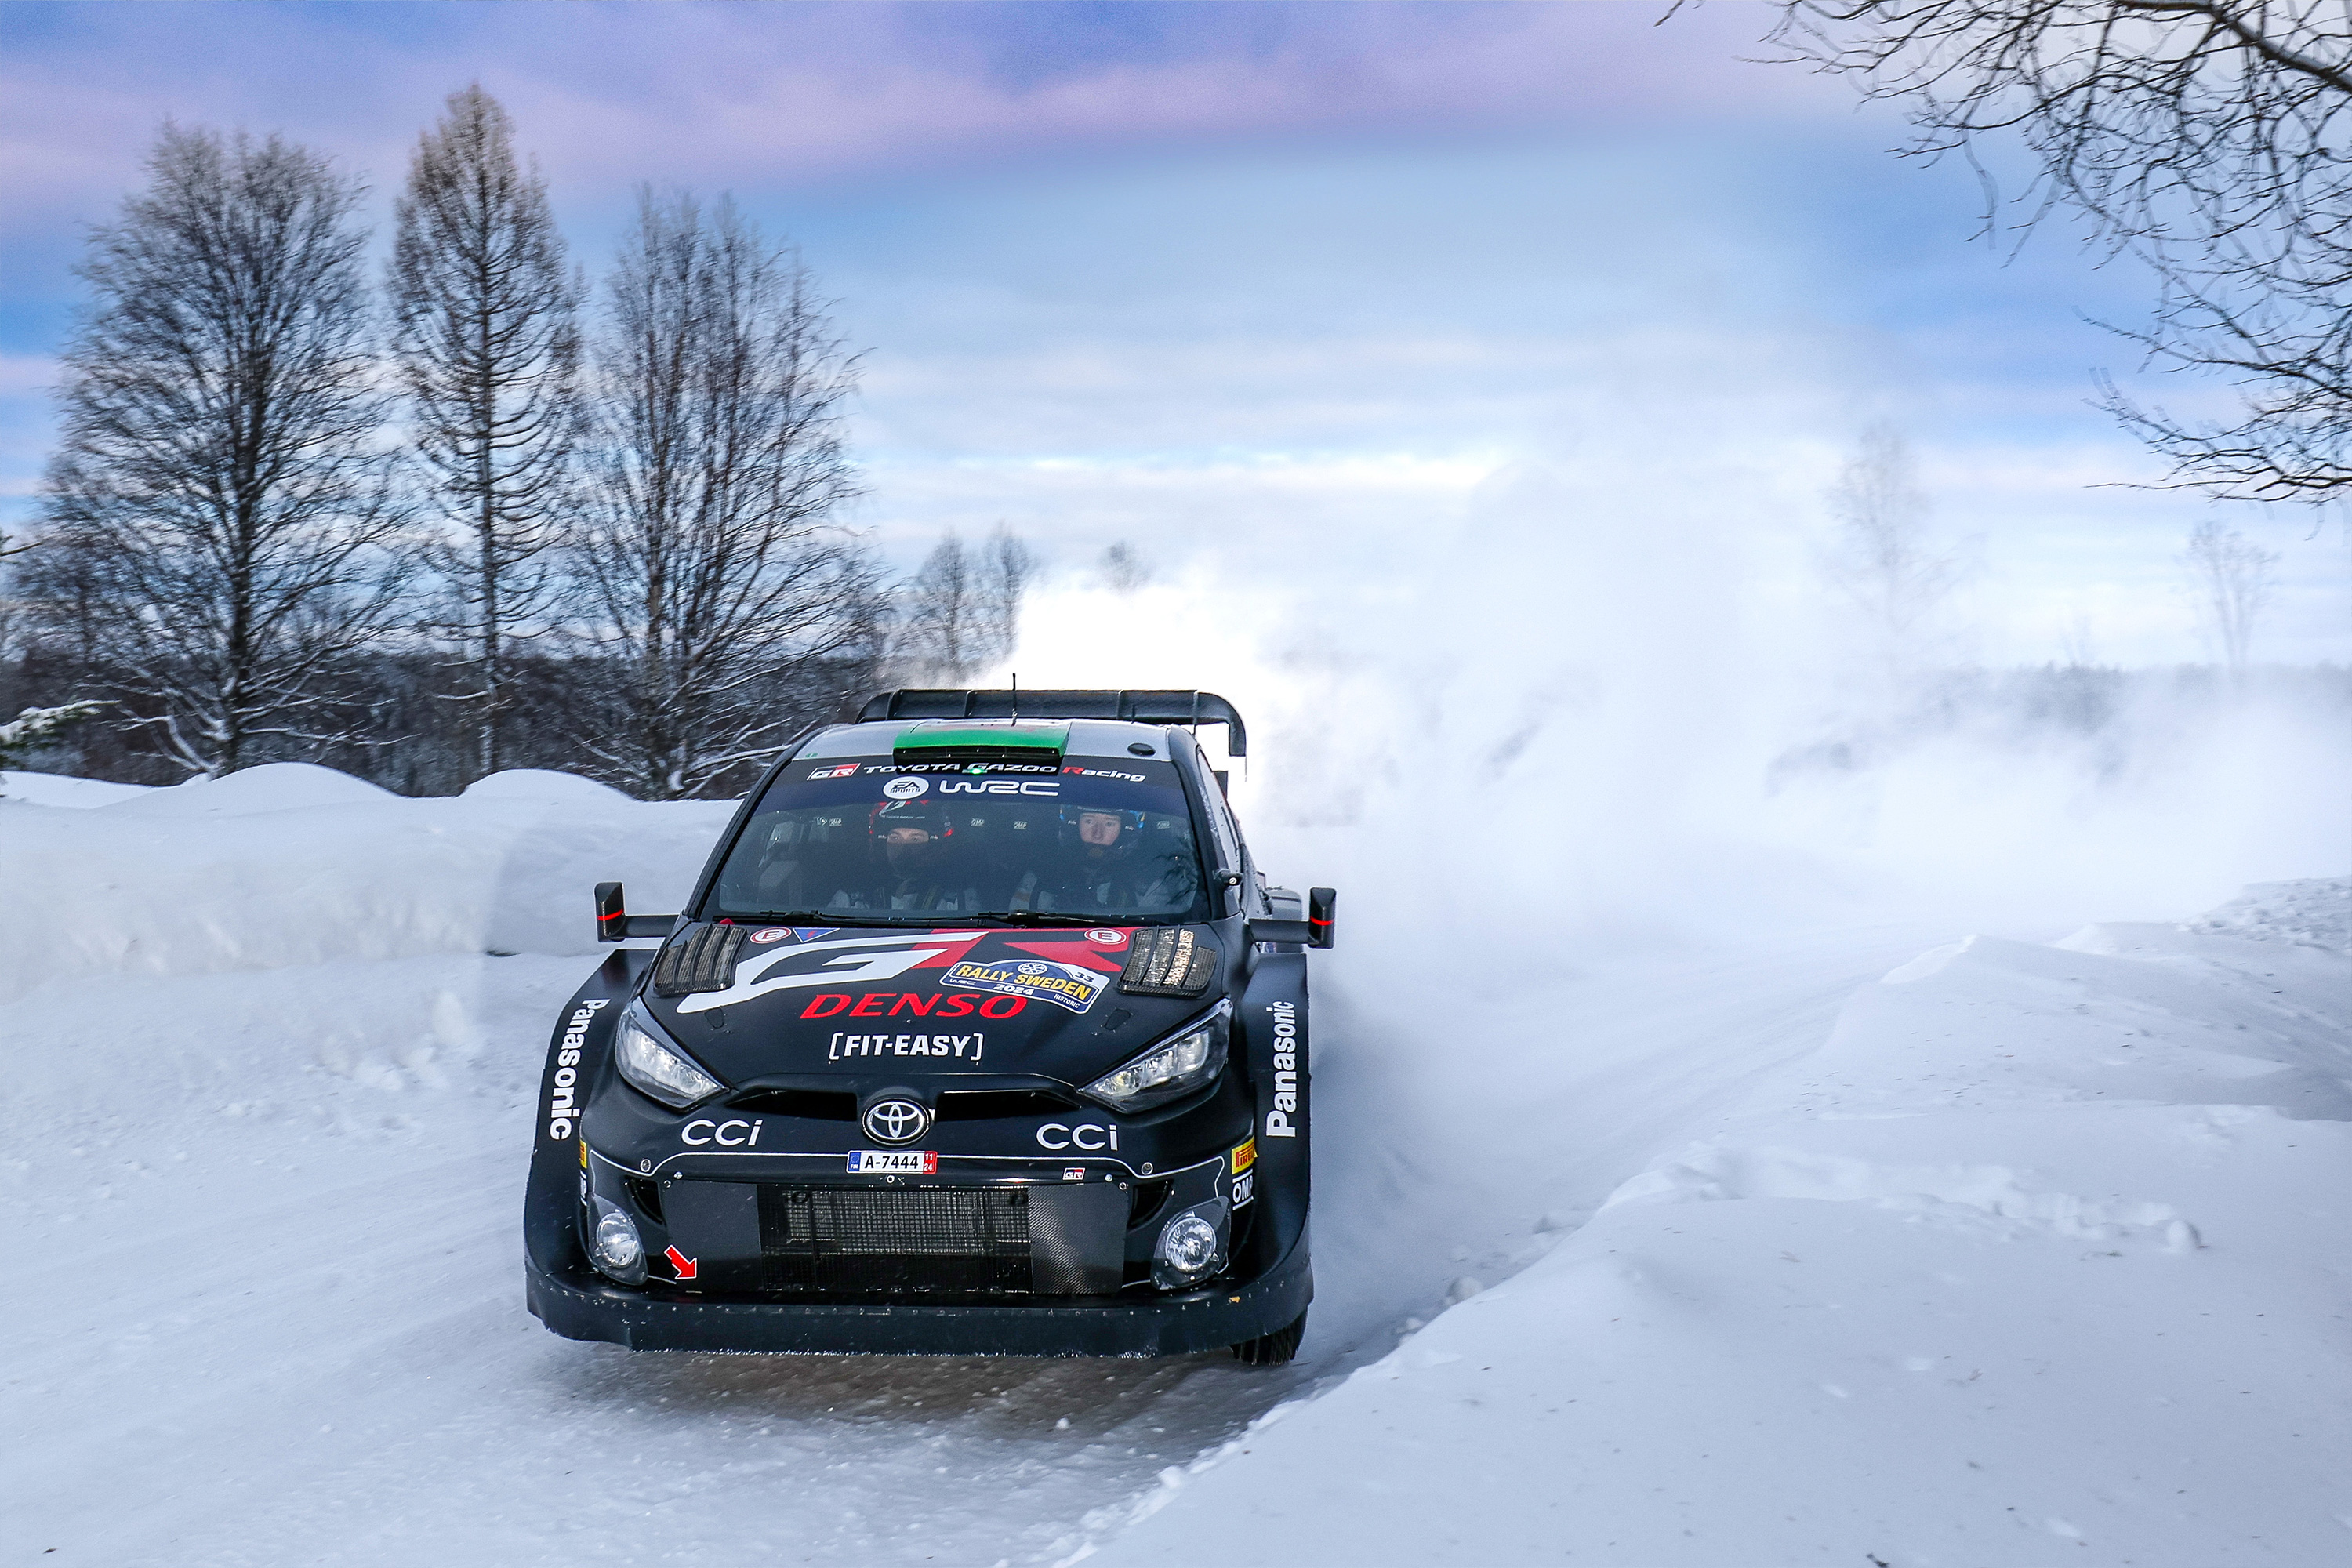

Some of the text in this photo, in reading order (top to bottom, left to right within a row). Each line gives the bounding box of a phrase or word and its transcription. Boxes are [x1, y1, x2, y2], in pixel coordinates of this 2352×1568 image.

[810, 762, 1146, 782] GR TOYOTA GAZOO Racing
[939, 779, 1060, 797] WRC
[762, 930, 779, 940] E
[1097, 931, 1113, 940] E
[955, 964, 1092, 1000] RALLY SWEDEN
[1074, 971, 1094, 982] 33
[993, 983, 1036, 996] 2024
[800, 993, 1027, 1018] DENSO
[1054, 993, 1081, 1009] HISTORIC
[549, 998, 611, 1141] Panasonic
[1266, 1000, 1296, 1138] Panasonic
[865, 1155, 918, 1169] A-7444
[1236, 1142, 1254, 1167] PIRE
[1063, 1169, 1084, 1181] GR
